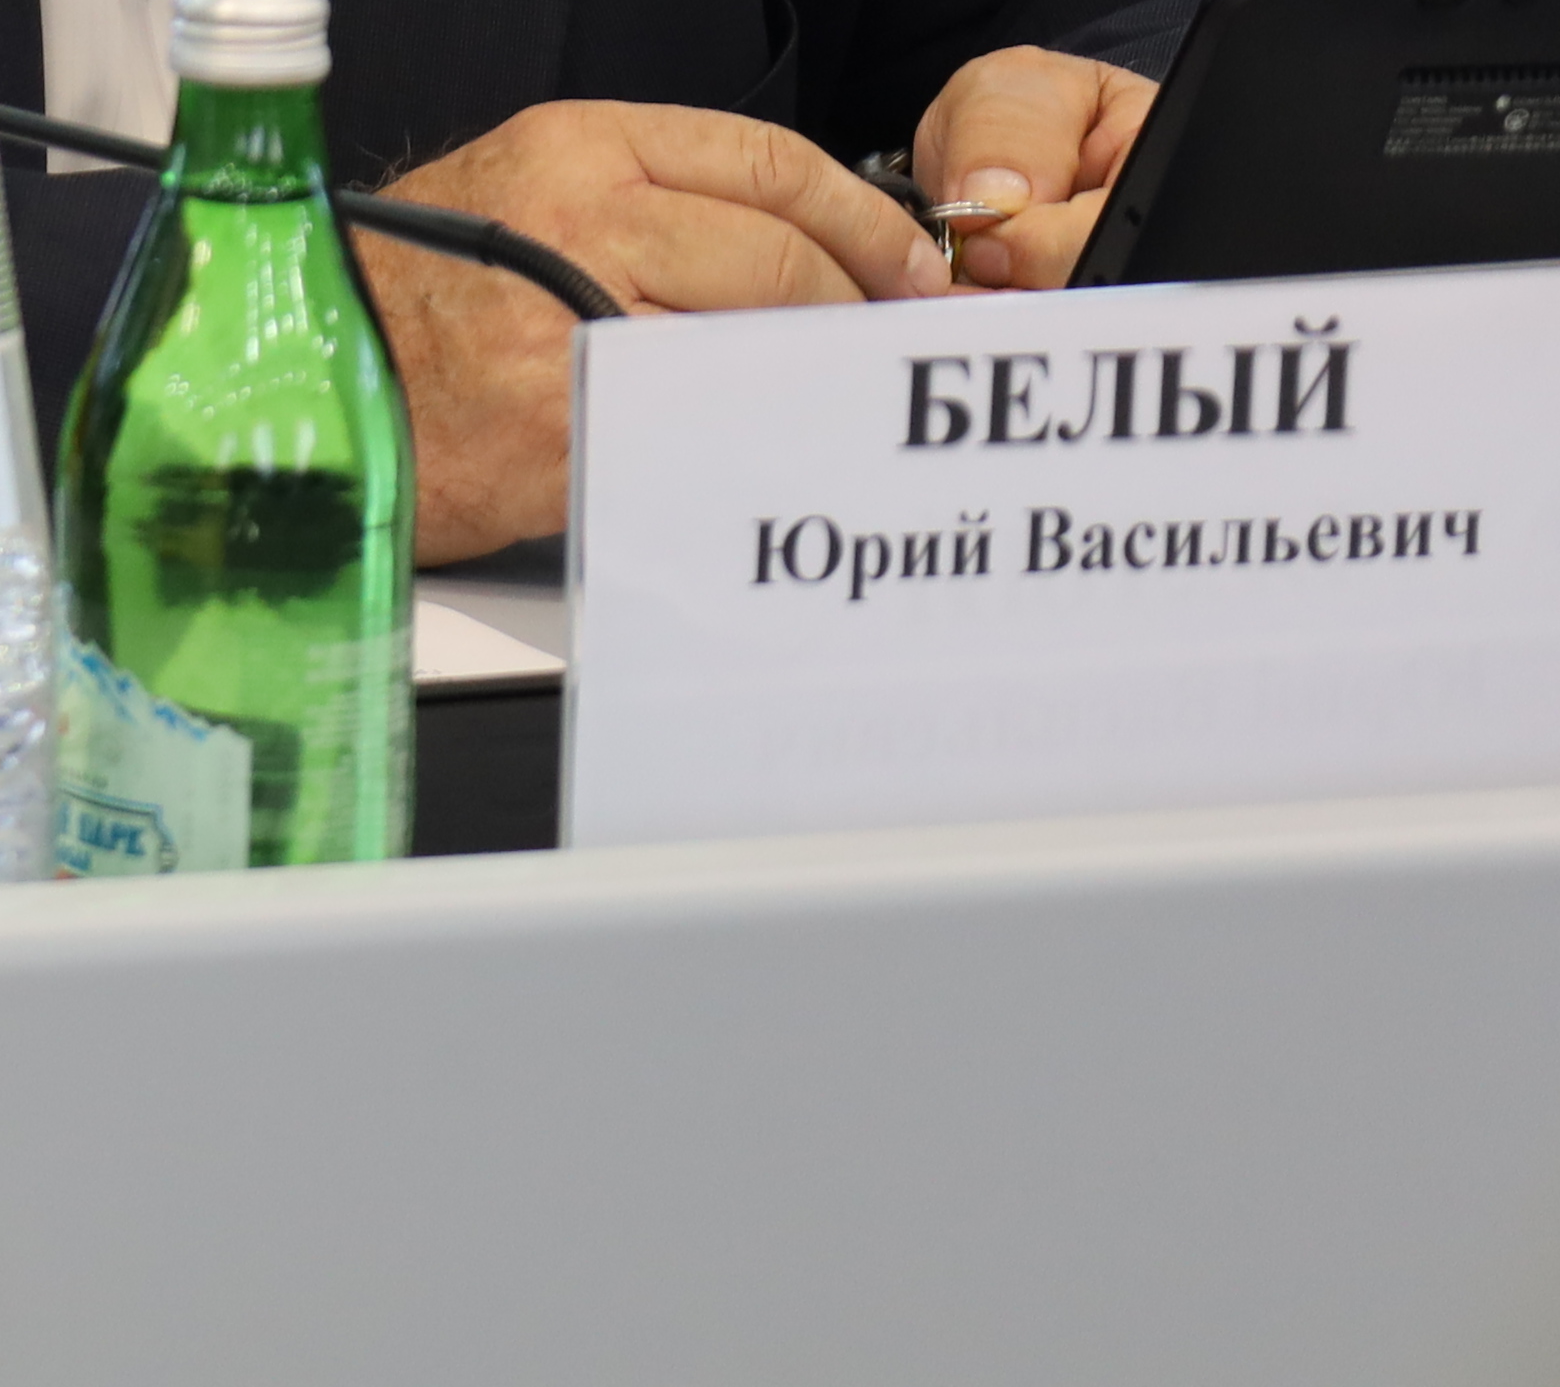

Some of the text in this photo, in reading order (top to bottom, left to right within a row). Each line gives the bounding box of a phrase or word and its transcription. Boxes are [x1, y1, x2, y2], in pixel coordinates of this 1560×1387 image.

[901, 316, 1357, 450] БЕЛЫЙ
[751, 506, 1484, 603] Юрий Васильевич
